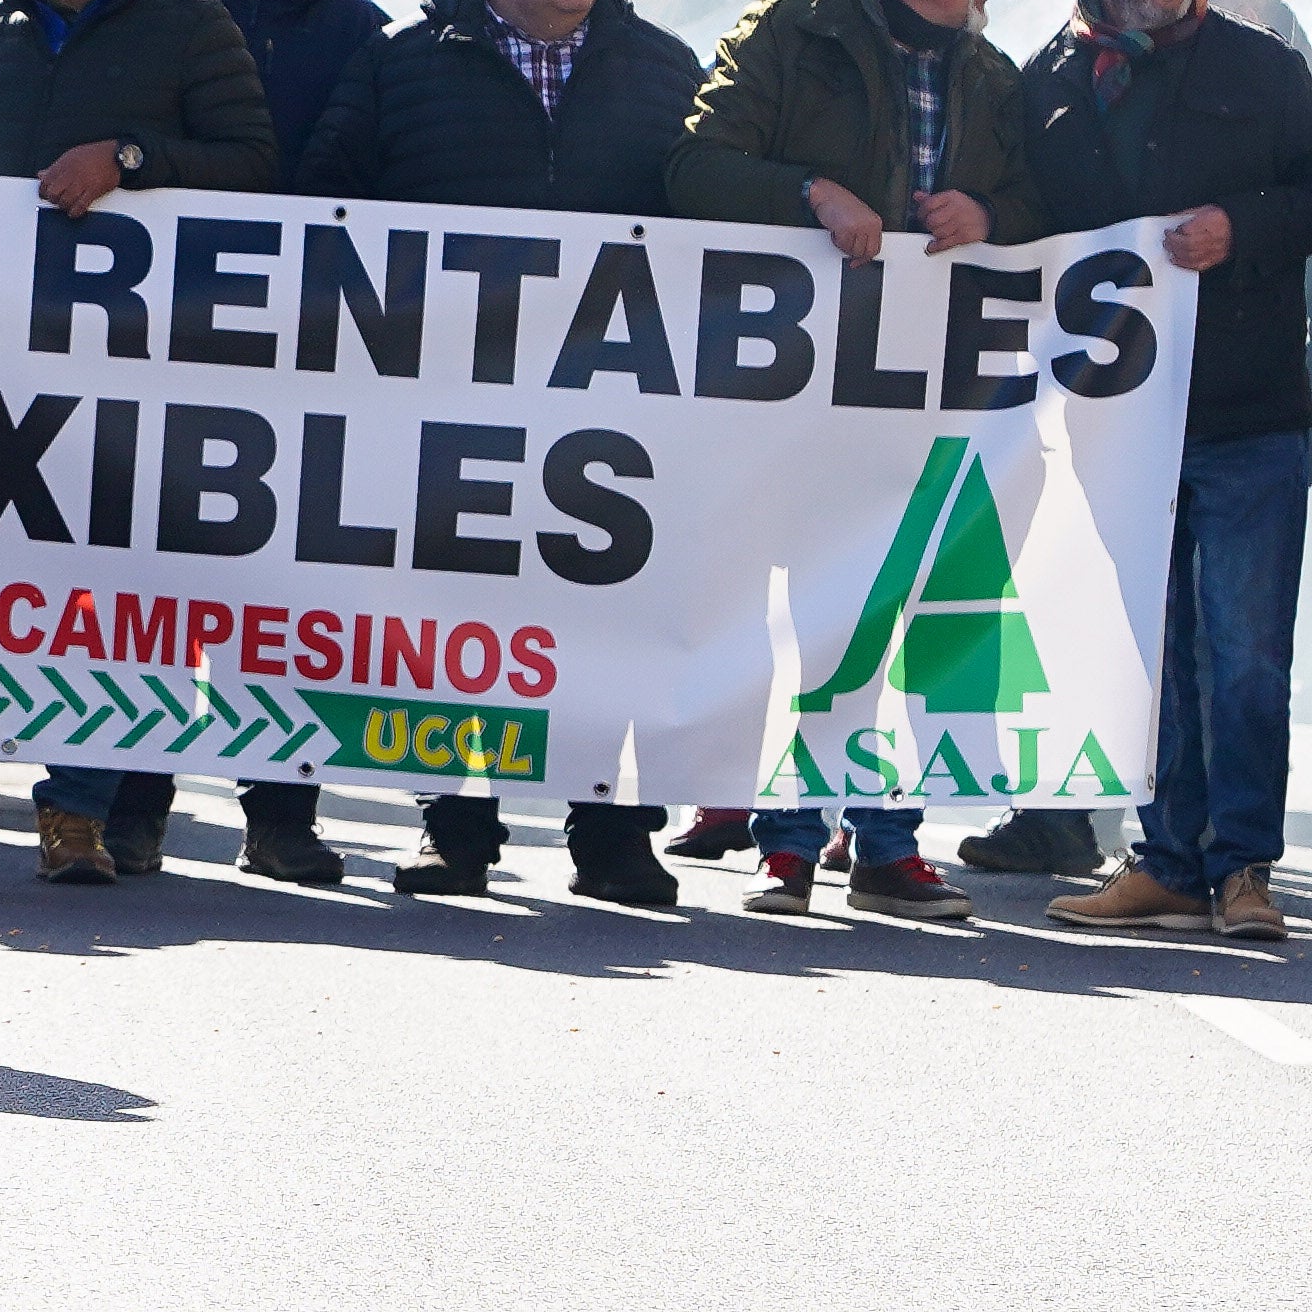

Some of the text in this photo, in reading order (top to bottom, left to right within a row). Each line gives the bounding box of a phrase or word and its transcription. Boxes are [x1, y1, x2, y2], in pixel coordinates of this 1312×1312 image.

[27, 205, 1159, 411] RENTABLES
[363, 707, 534, 775] UCCL
[758, 726, 1132, 798] ASAJA
